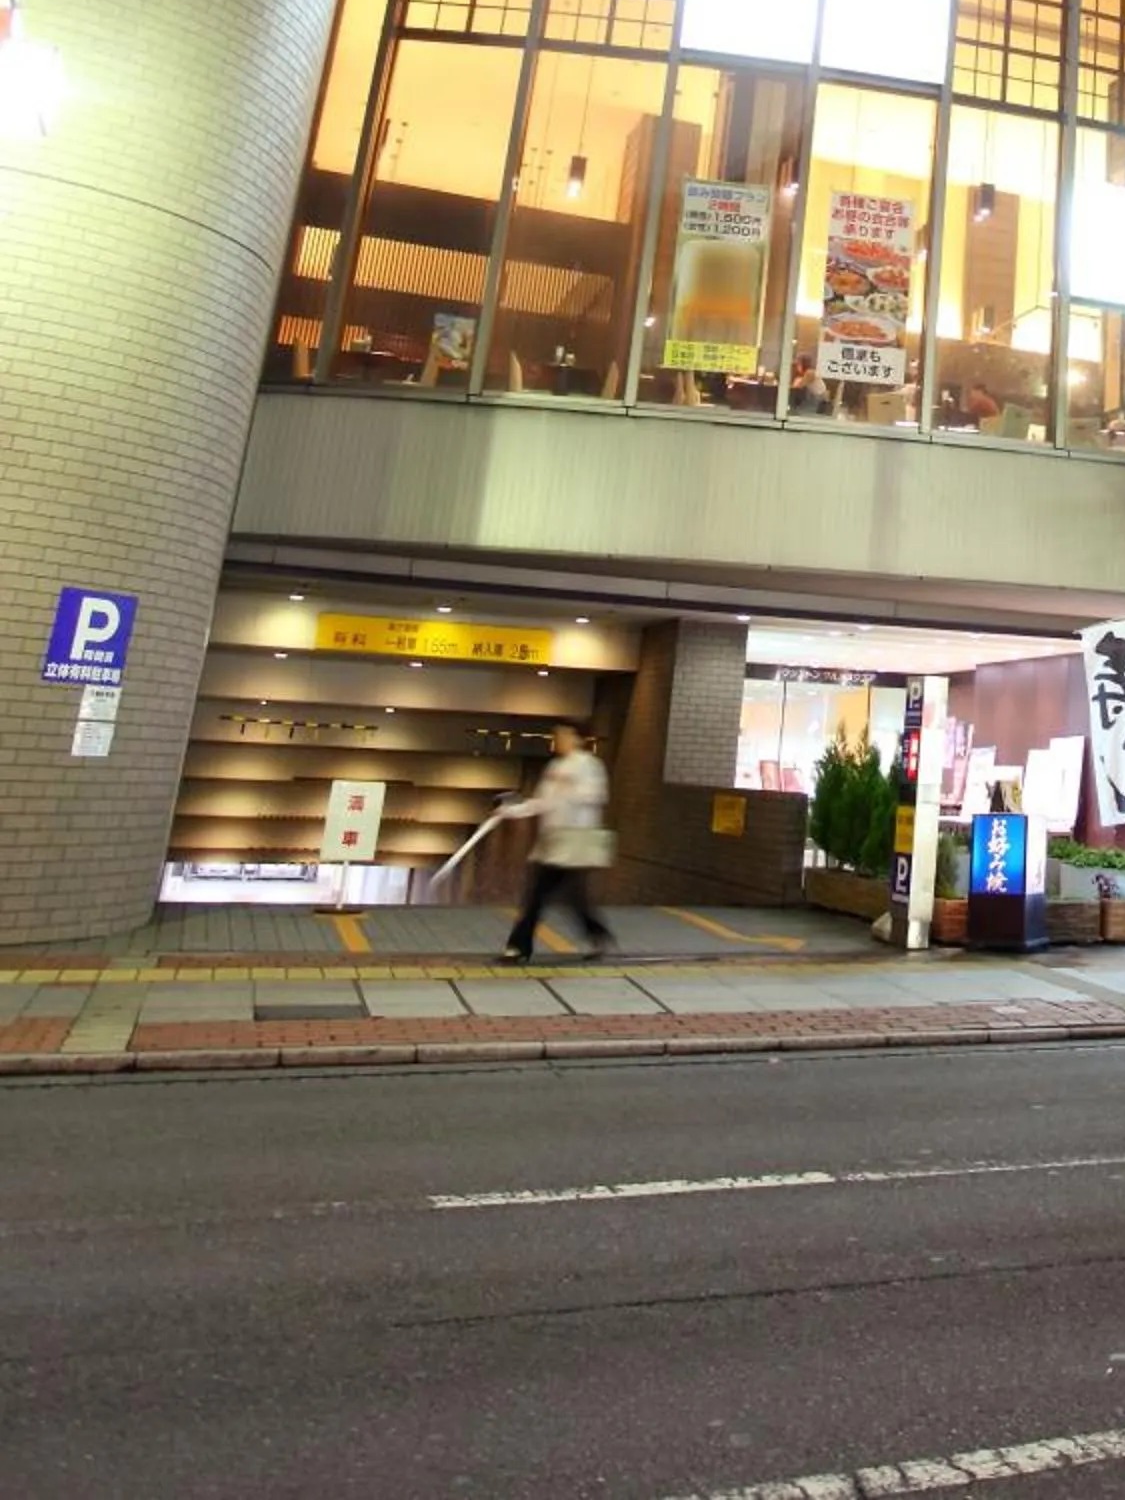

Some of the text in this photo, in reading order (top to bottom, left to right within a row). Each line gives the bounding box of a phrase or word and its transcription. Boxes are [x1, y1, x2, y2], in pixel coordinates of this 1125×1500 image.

[827, 360, 893, 378] ございます
[69, 597, 121, 661] P
[986, 817, 1011, 894] お好み焼
